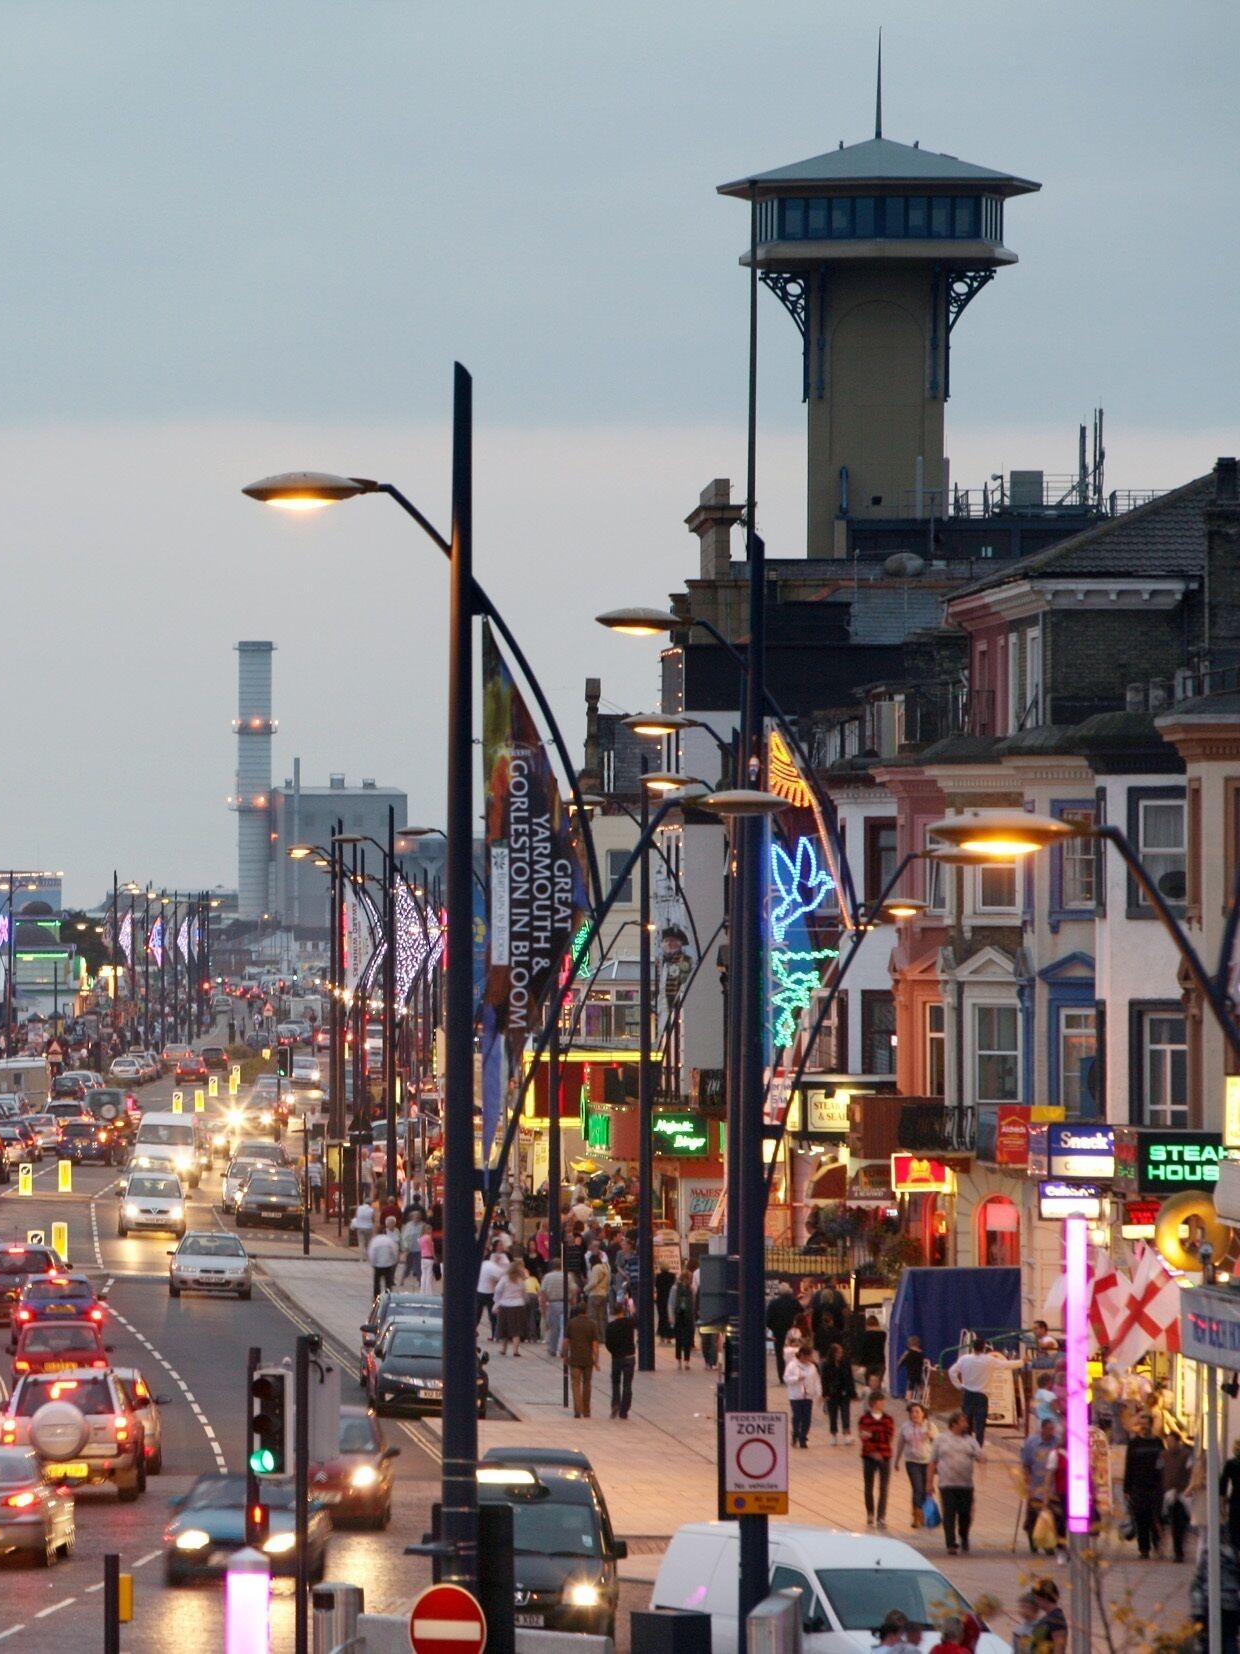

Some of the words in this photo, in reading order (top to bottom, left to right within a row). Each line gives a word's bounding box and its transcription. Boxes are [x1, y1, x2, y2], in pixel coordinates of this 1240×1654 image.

[509, 760, 530, 899] GORLESTON
[531, 813, 552, 948] YARMOUTH
[553, 859, 572, 931] GREAT
[511, 908, 530, 932] IN
[531, 957, 551, 976] &
[508, 941, 529, 1028] BLOOM
[1147, 1165, 1220, 1180] HOUS
[730, 1414, 782, 1422] PEDESTRIAN
[737, 1423, 775, 1434] ZONE
